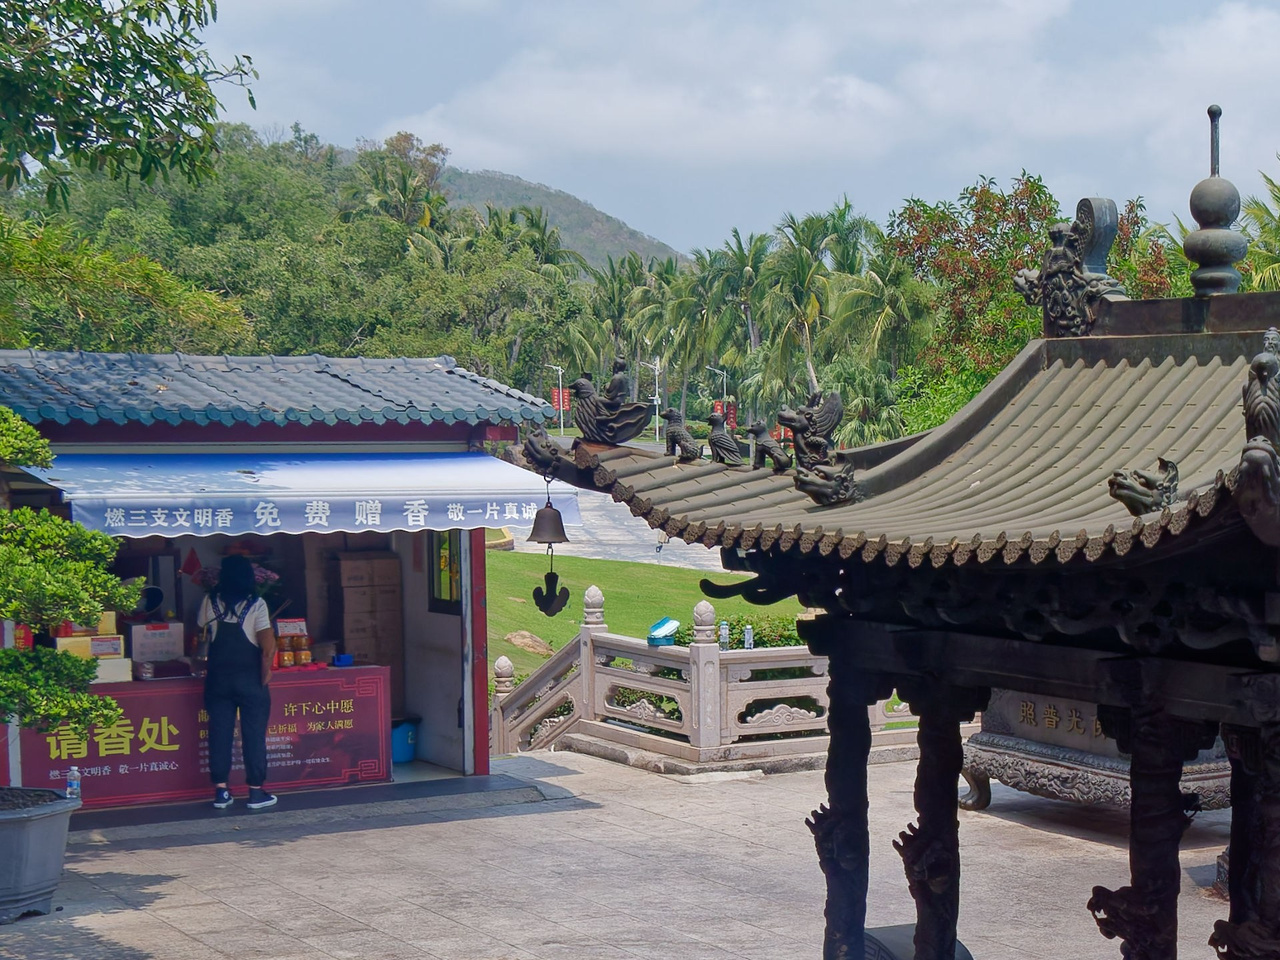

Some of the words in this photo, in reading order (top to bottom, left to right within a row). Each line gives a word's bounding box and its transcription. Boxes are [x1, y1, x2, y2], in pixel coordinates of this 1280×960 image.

[104, 507, 234, 528] 燃三支文明香
[253, 500, 430, 528] 免费赠香
[284, 699, 354, 716] 许下心中愿
[46, 716, 181, 760] 请香处
[49, 764, 112, 780] 燃三文明香
[118, 761, 179, 775] 敬一片真诚心
